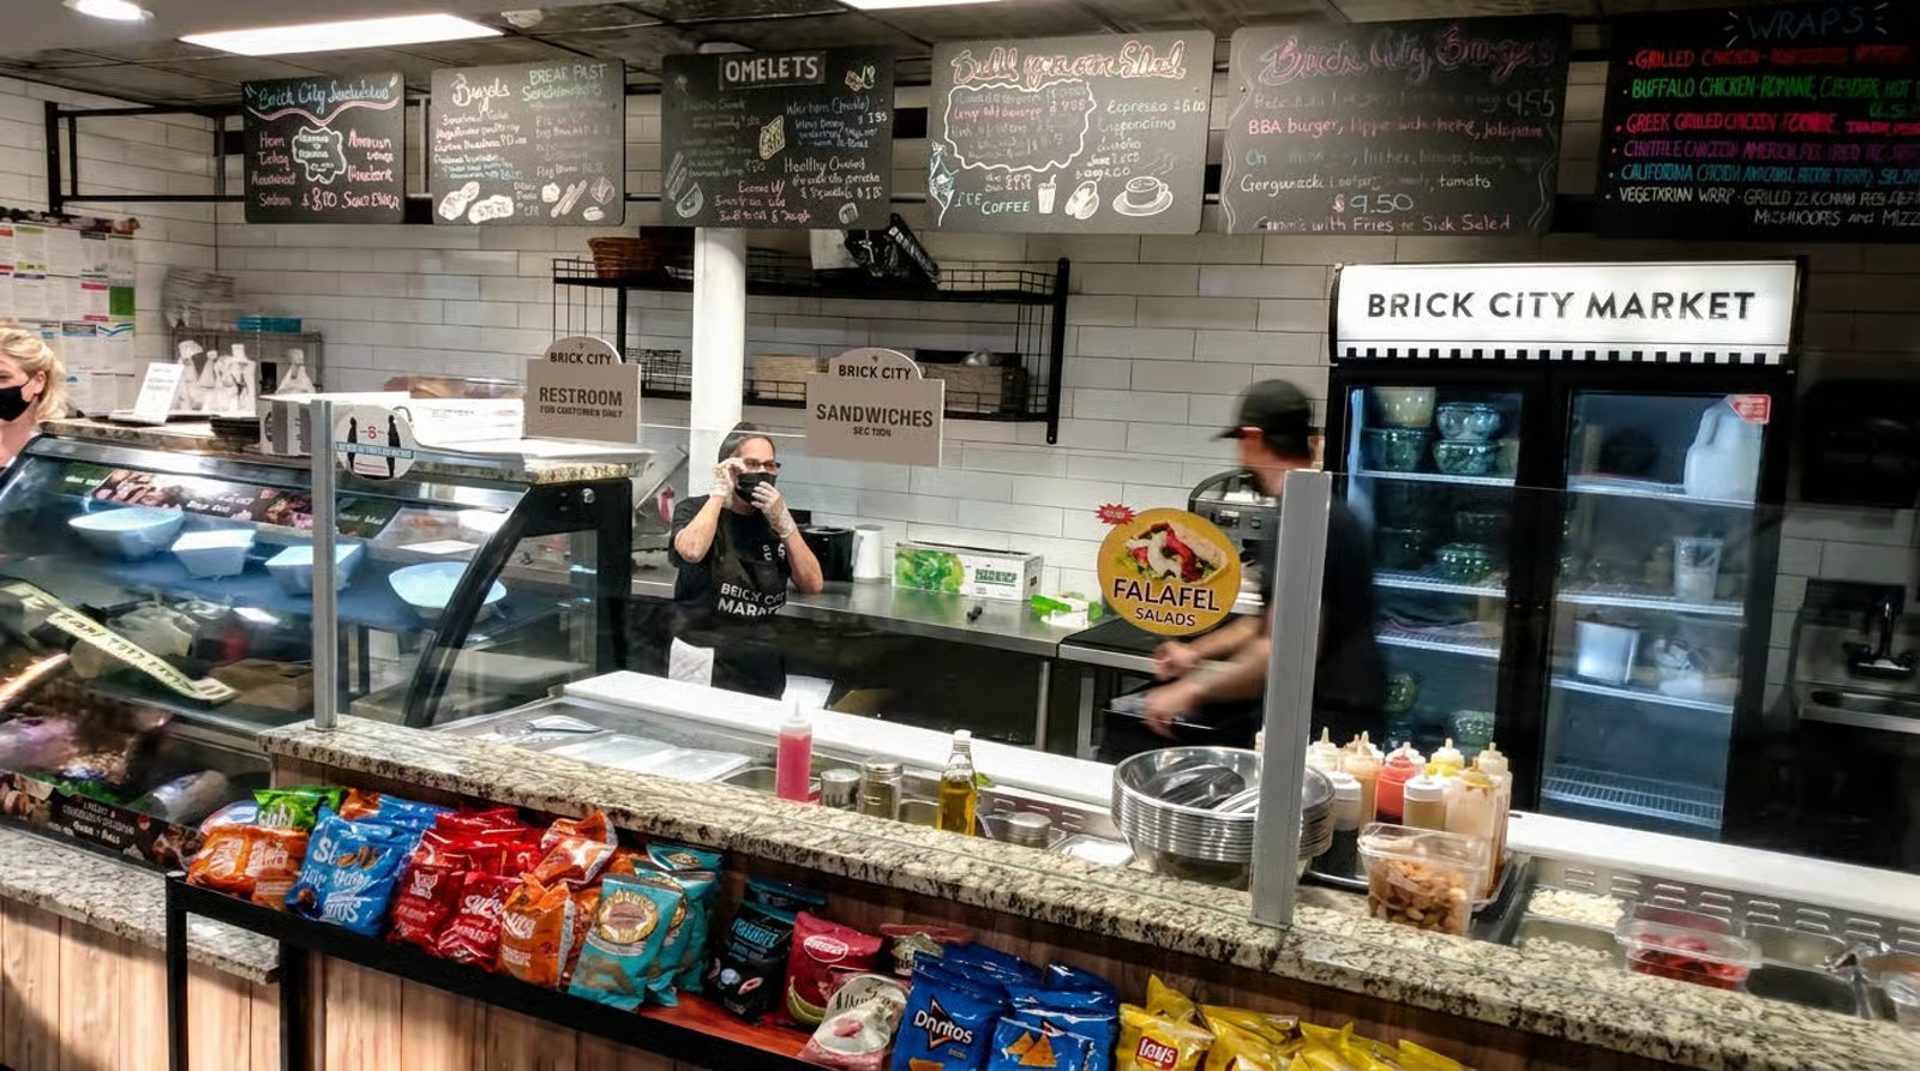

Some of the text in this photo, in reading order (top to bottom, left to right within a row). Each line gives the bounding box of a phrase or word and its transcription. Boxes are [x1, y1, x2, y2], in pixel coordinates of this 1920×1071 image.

[1747, 7, 1864, 39] WRAPS
[1635, 48, 1694, 69] GRILLED
[725, 56, 818, 83] OMELETS
[1632, 77, 1695, 99] BUFFALO
[1626, 113, 1669, 133] GREEK
[981, 200, 1031, 215] COFFEE
[1312, 216, 1346, 232] with
[1353, 216, 1395, 232] Fries
[1368, 292, 1475, 318] BRICK
[1586, 291, 1755, 320] MARKET
[550, 352, 612, 365] BRICK CITY
[838, 364, 911, 380] BRICK CITY
[539, 386, 622, 406] RESTROOM
[816, 403, 934, 428] SANDWICHES
[1113, 578, 1220, 612] FALAFEL
[1135, 607, 1197, 627] SALADS
